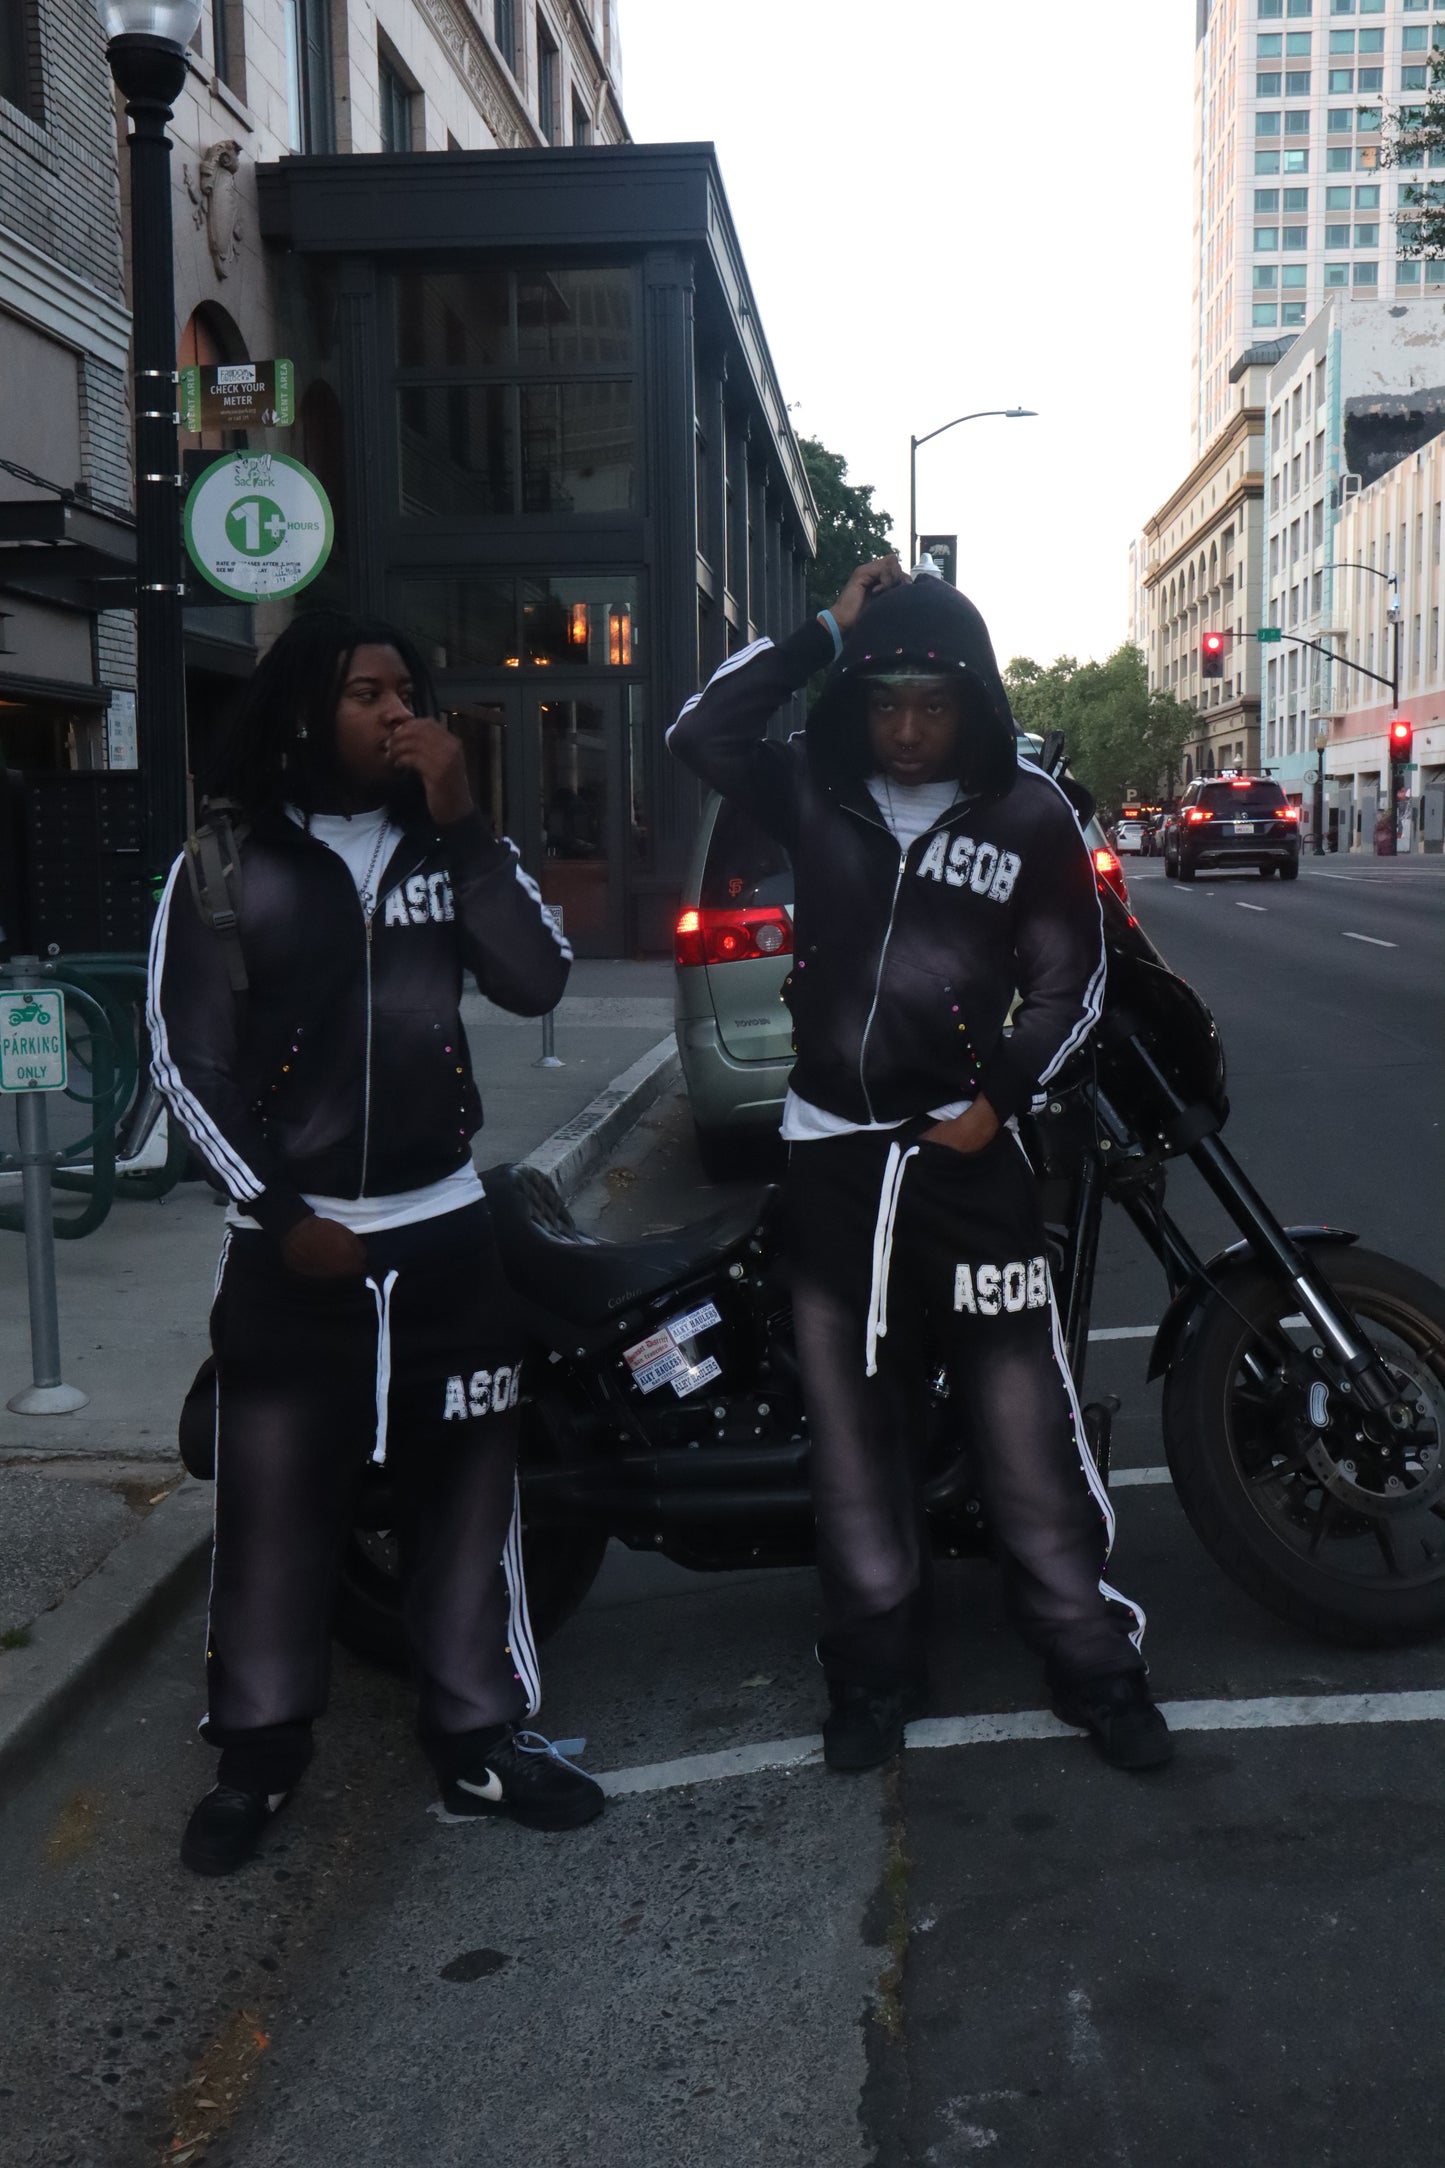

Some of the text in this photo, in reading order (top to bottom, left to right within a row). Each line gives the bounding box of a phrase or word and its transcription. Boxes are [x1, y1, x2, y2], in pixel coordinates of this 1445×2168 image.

[210, 383, 265, 395] CHECK YOUR
[280, 363, 289, 425] EVENT AREA
[187, 370, 196, 430] EVENT AREA
[223, 395, 252, 406] METER
[287, 521, 320, 531] HOURS
[1126, 788, 1138, 802] P
[915, 829, 1022, 904] ASOB
[3, 1035, 59, 1056] PARKING
[17, 1066, 47, 1080] ONLY
[953, 1255, 1047, 1316] ASOB
[607, 1289, 642, 1309] Corbin
[689, 1309, 718, 1329] HAULERS
[639, 1372, 656, 1386] ALKY
[654, 1356, 683, 1377] HAULERS
